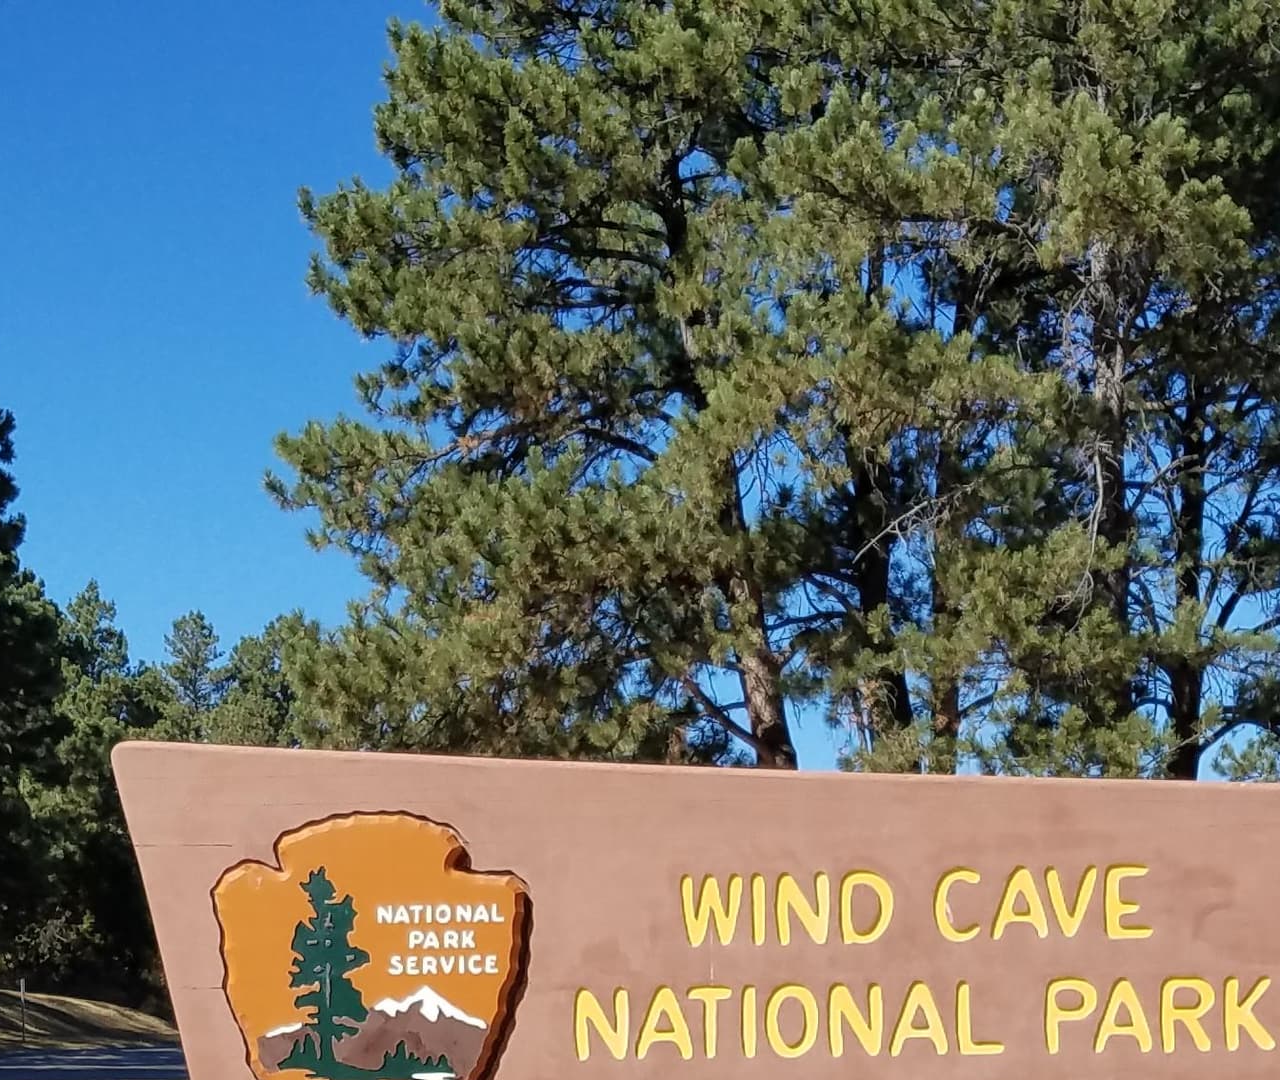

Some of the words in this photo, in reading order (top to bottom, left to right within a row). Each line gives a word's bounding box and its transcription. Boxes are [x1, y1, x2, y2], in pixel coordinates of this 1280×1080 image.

[375, 903, 505, 925] NATIONAL
[680, 868, 895, 946] WIND
[933, 863, 1154, 942] CAVE
[408, 929, 476, 950] PARK
[387, 954, 499, 976] SERVICE
[573, 980, 1005, 1060] NATIONAL
[1044, 975, 1276, 1055] PARK
